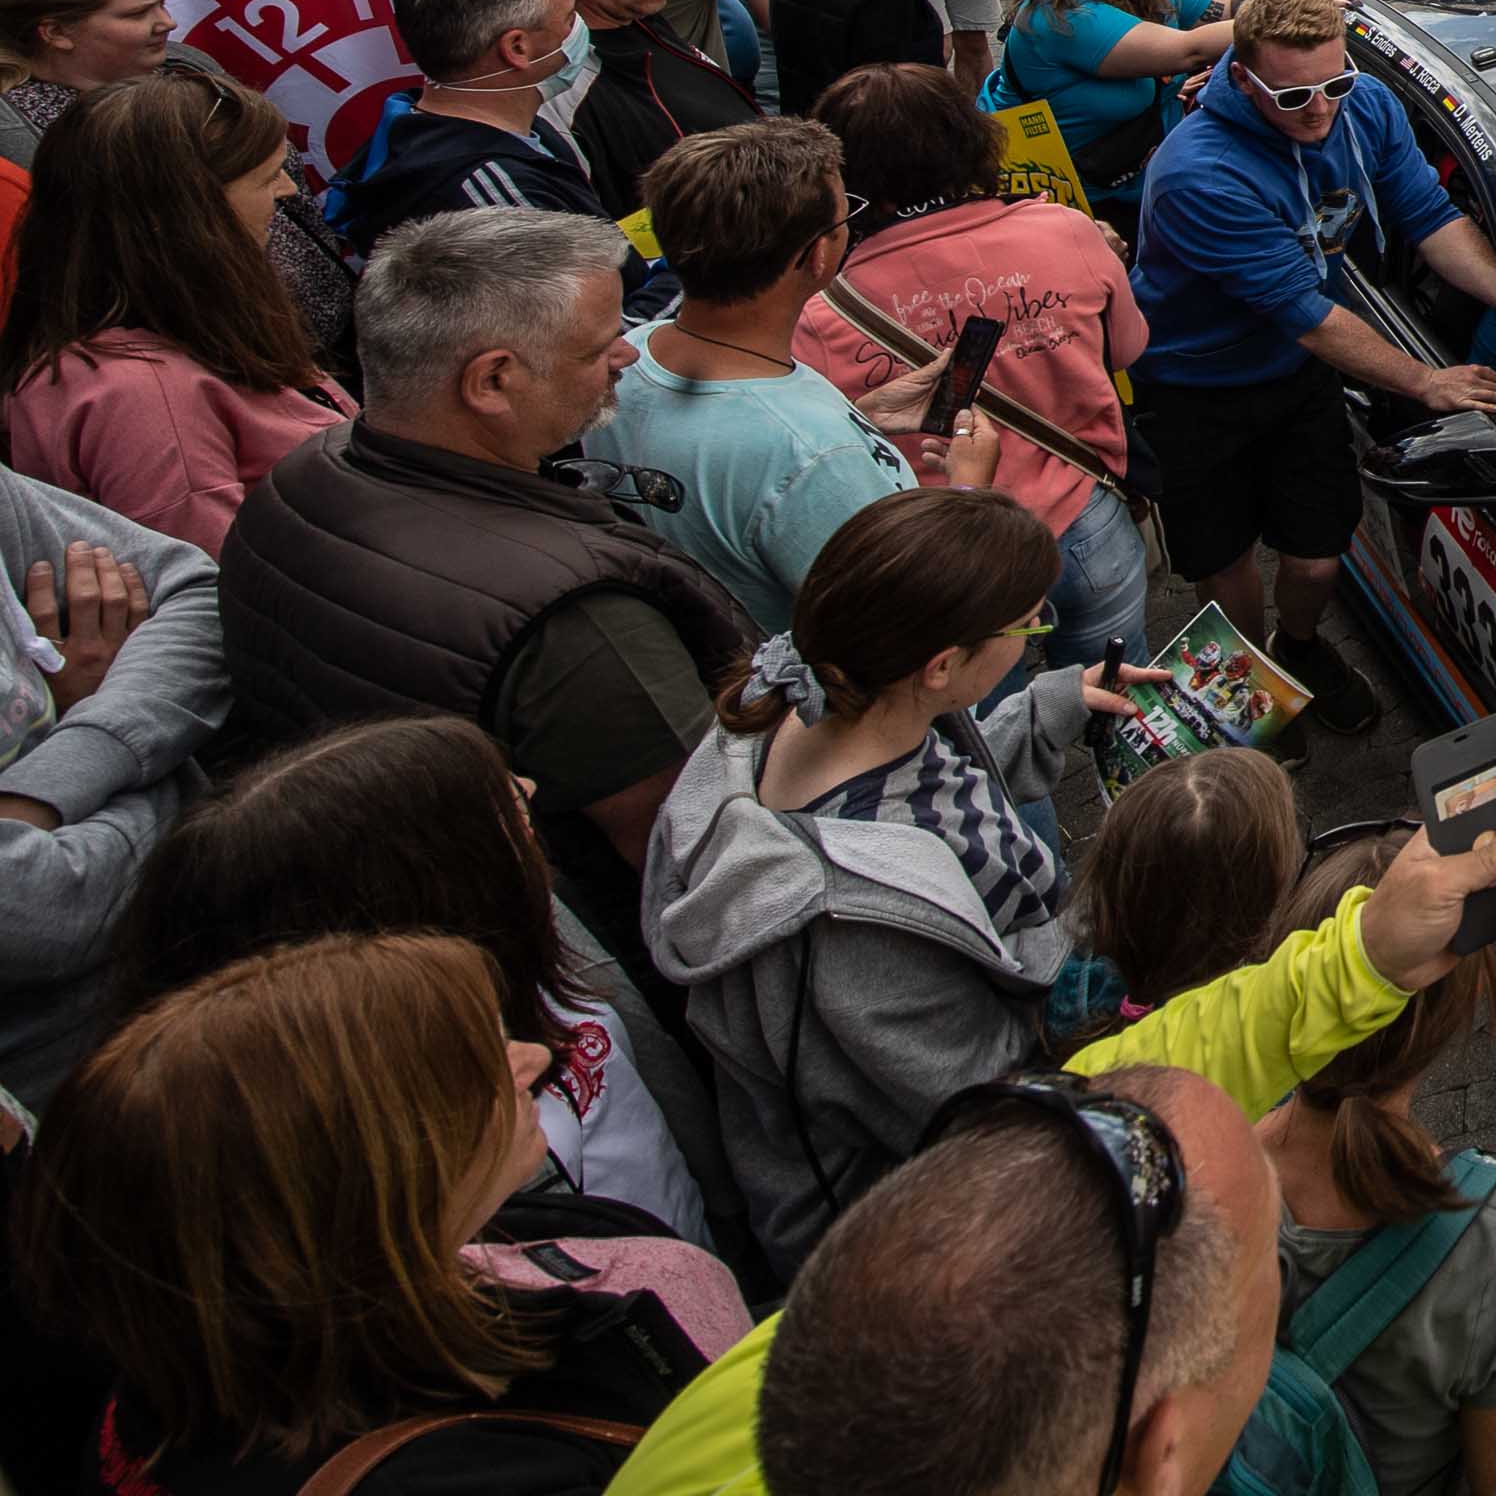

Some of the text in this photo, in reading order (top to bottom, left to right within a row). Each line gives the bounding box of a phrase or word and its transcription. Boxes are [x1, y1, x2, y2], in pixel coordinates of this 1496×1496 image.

[1371, 30, 1398, 58] Endres
[1416, 68, 1441, 94] Ricca
[1459, 114, 1493, 161] Mertens
[965, 271, 1031, 306] Ocean
[1143, 704, 1180, 746] 12h
